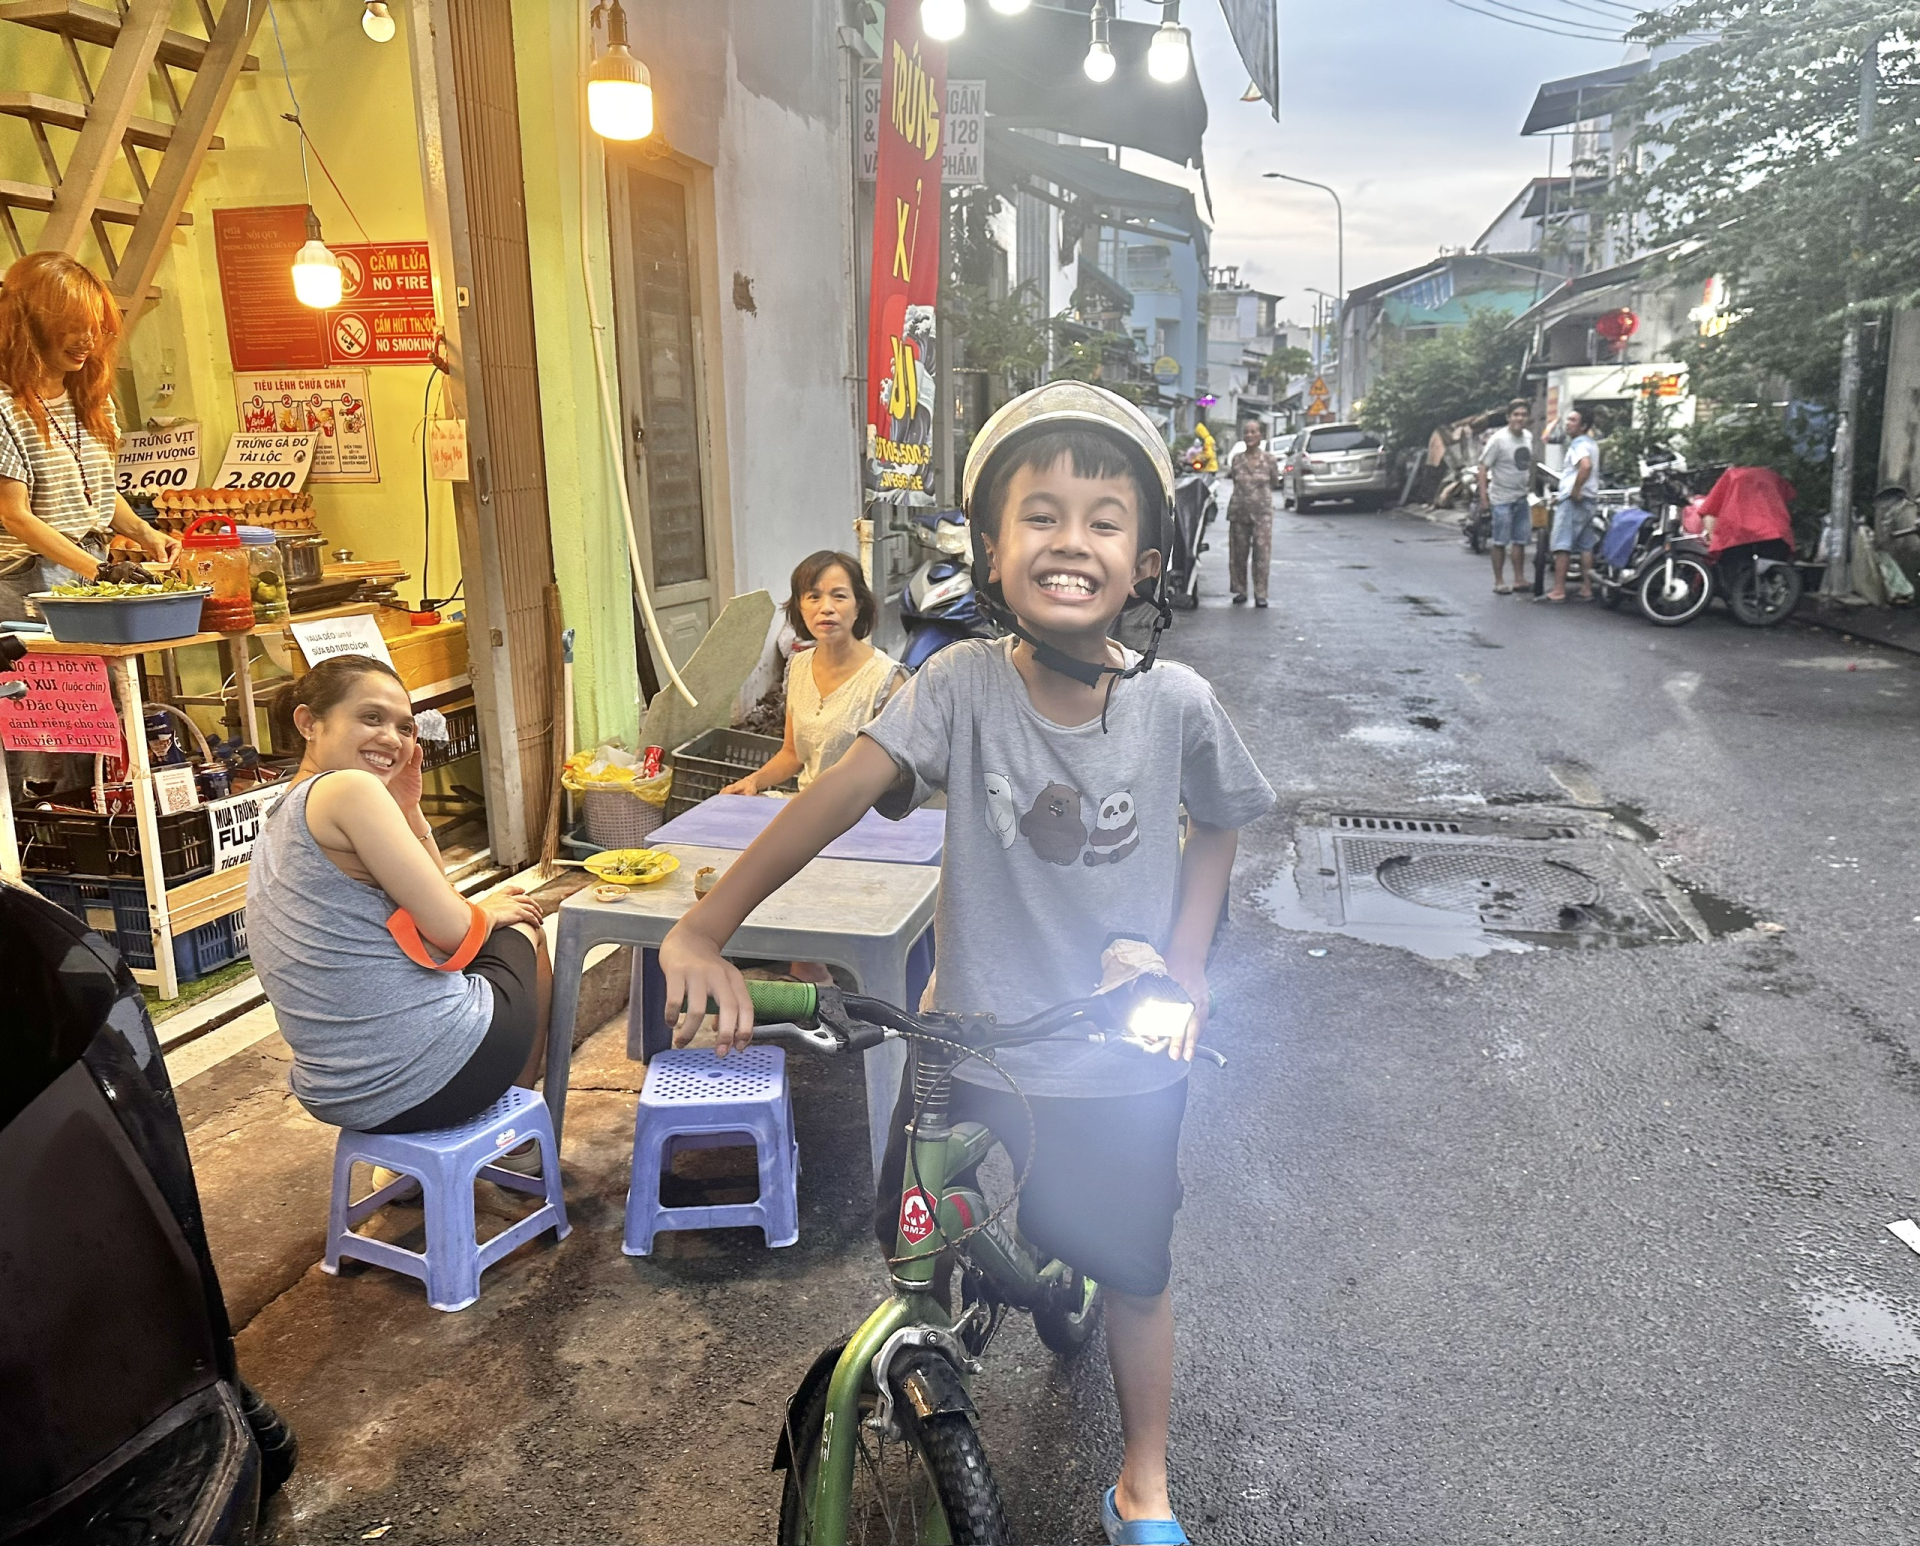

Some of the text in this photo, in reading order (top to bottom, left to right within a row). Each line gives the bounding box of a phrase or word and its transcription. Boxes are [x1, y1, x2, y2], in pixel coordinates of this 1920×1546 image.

[892, 39, 940, 161] TRỨNG
[945, 85, 980, 115] GÂN
[864, 119, 876, 142] &
[950, 119, 979, 145] 128
[369, 248, 428, 271] CẤM LỬA
[373, 275, 429, 290] NO FIRE
[374, 312, 391, 333] CẤM
[393, 313, 408, 333] HÚT
[376, 337, 436, 352] NO SMOKIN
[275, 379, 296, 393] LỆNH
[299, 378, 322, 390] CHỮA
[324, 377, 346, 390] CHÁY
[132, 430, 195, 448] TRỨNG VỊT
[236, 437, 273, 448] TRỨNG
[275, 436, 289, 448] GÀ
[292, 435, 309, 447] ĐỎ
[117, 446, 196, 464] THỊNH VƯỢNG
[239, 450, 282, 463] TÀI LỘC
[116, 467, 188, 490] 3.600
[225, 471, 296, 489] 2.800
[57, 660, 79, 675] hột
[81, 660, 99, 675] vịt
[33, 679, 58, 690] XUI
[62, 681, 84, 693] (luộc
[85, 681, 107, 693] chín)
[26, 698, 99, 714] Đặc Quyền
[9, 717, 116, 730] dành riêng cho của
[12, 733, 116, 747] hội viên Fuji VIP
[214, 799, 259, 830] MUA TRỨNG
[219, 820, 260, 851] FUJI
[221, 854, 240, 870] TÍCH
[903, 1223, 927, 1236] BMZ
